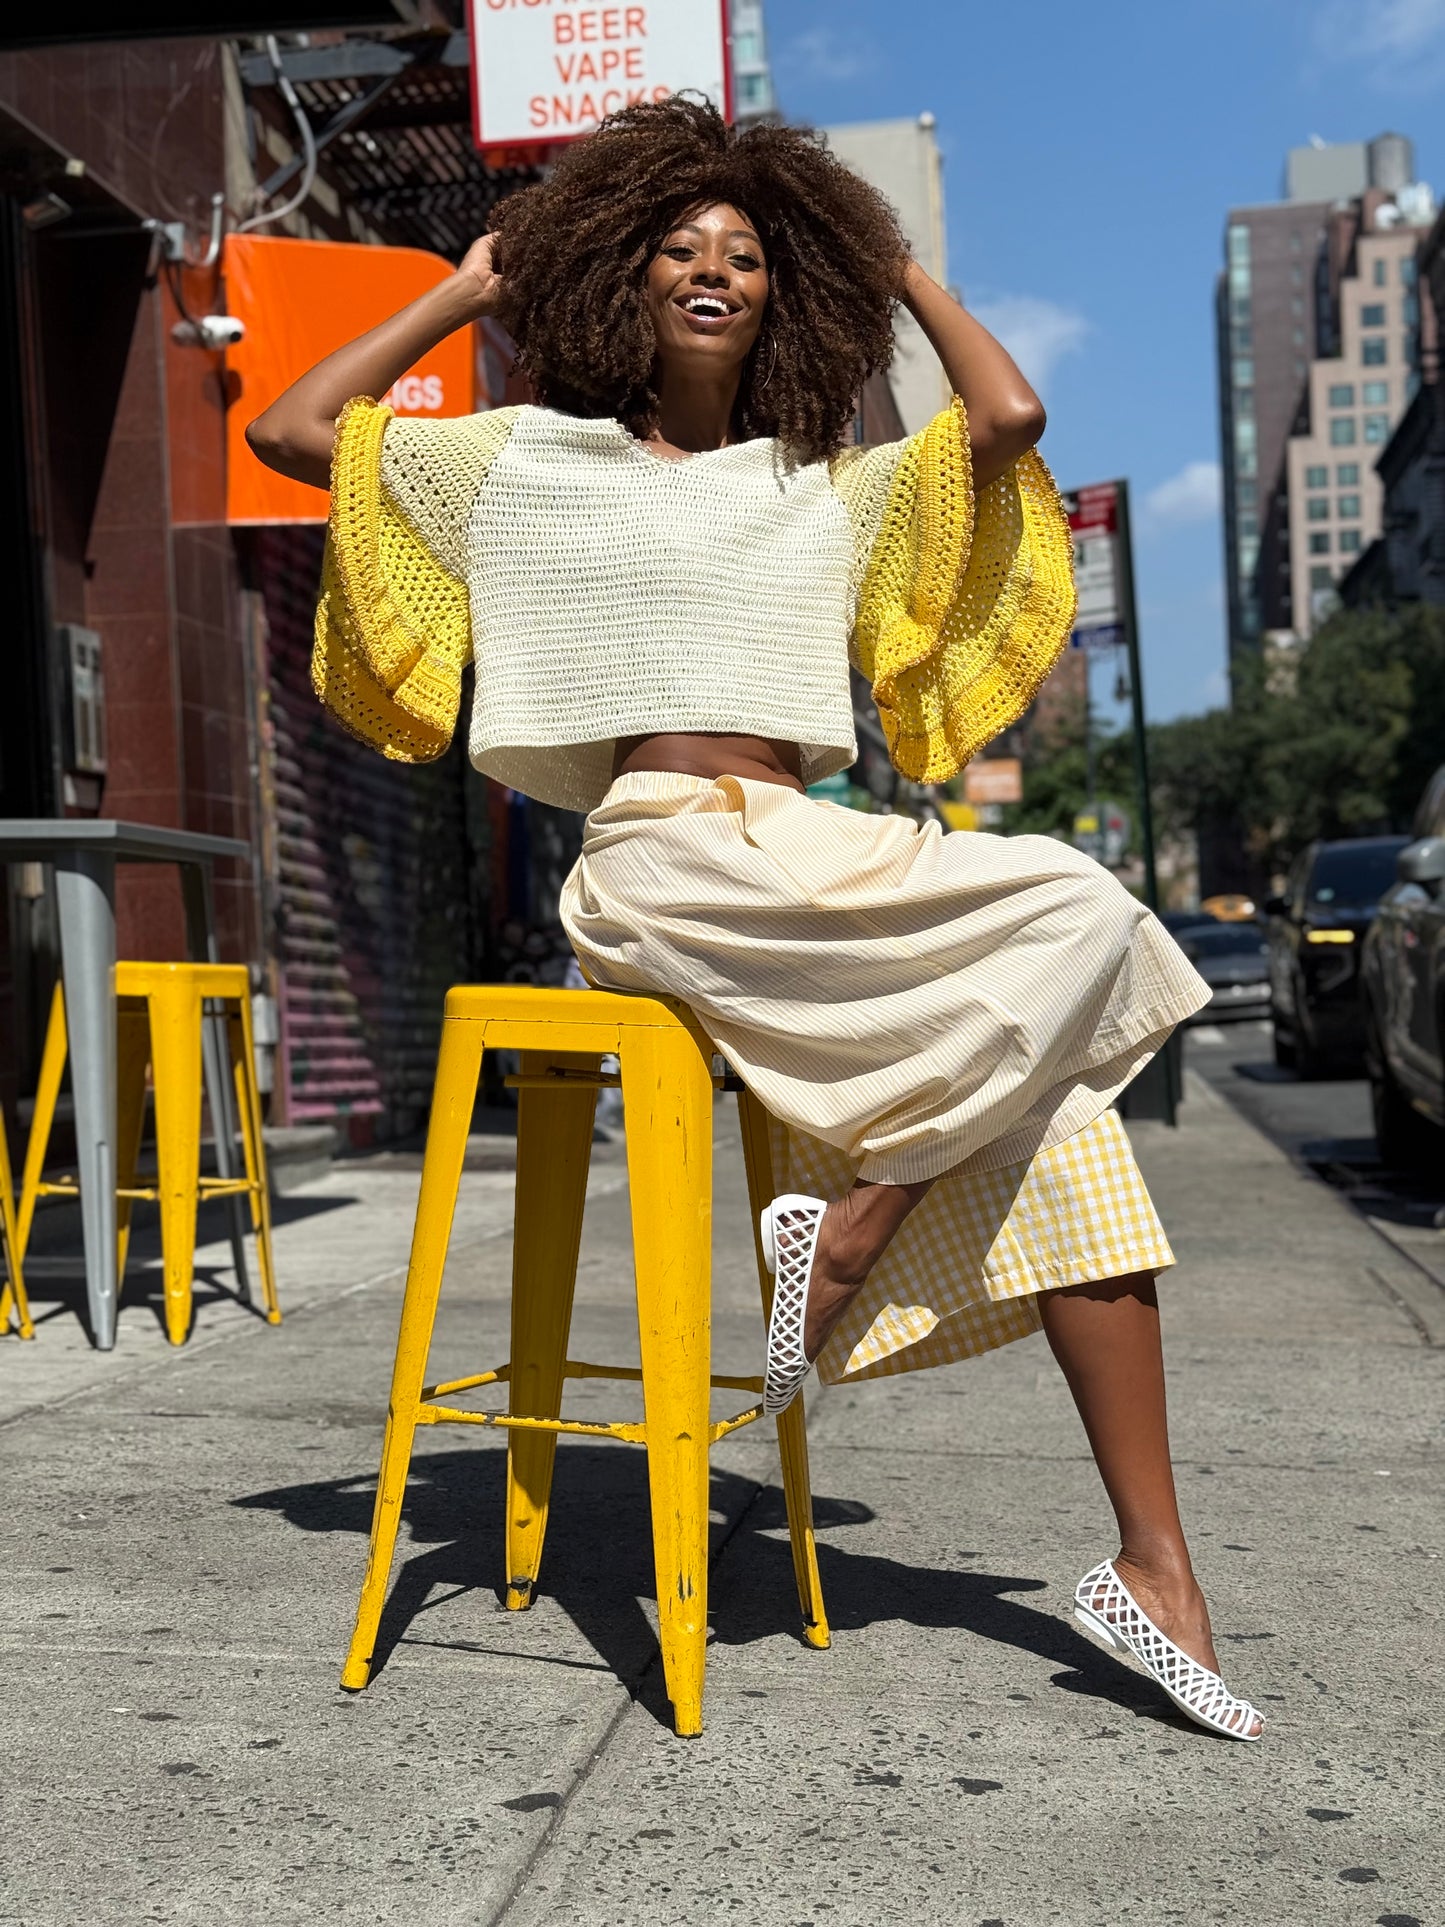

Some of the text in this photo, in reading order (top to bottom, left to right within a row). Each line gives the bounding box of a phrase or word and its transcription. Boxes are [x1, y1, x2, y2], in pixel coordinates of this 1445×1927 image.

[555, 7, 646, 43] BEER
[555, 48, 645, 84] VAPE
[383, 375, 443, 411] IGS
